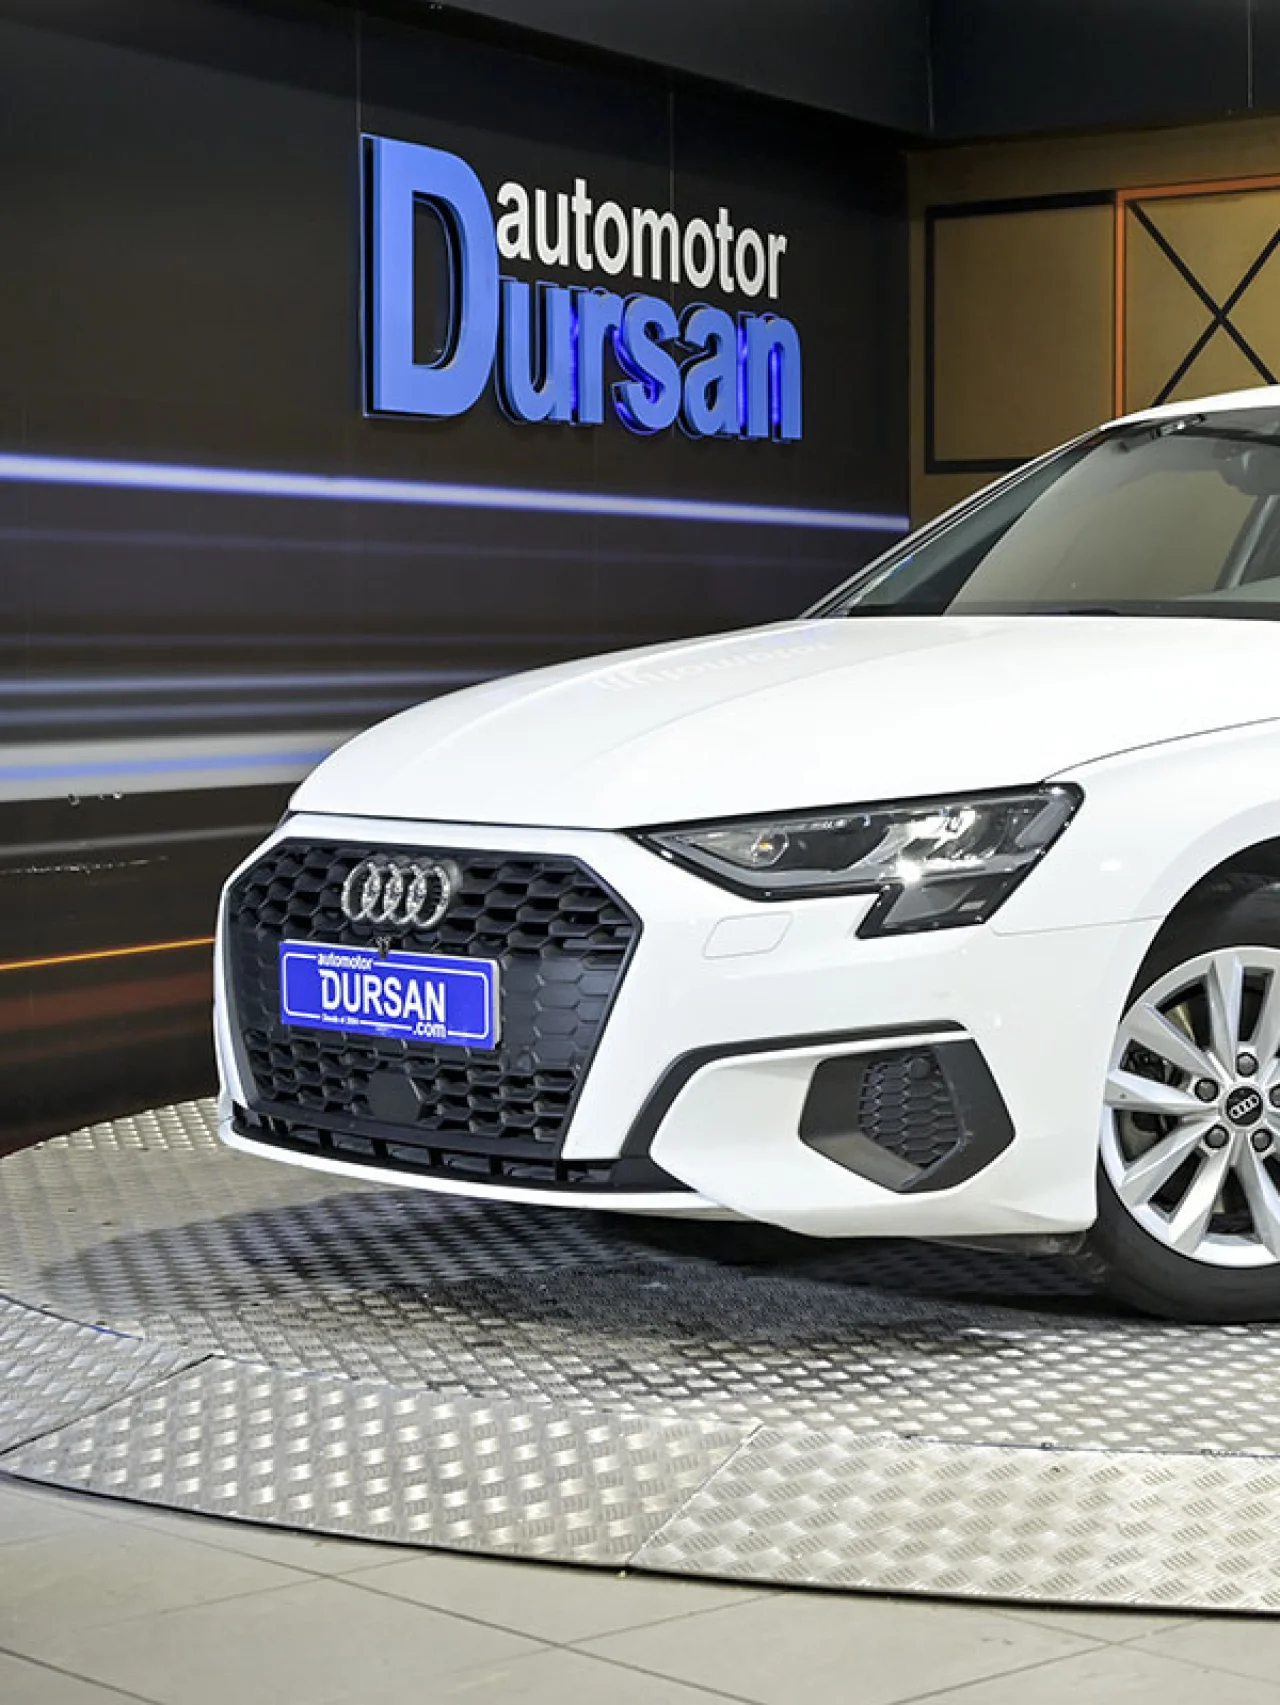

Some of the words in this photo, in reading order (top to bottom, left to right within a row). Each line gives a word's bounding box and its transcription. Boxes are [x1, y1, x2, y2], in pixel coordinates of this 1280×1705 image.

[496, 178, 788, 299] automotor
[360, 132, 803, 442] Dursan
[317, 952, 374, 970] automotor
[318, 968, 447, 1023] DURSAN
[413, 1020, 447, 1039] .com
